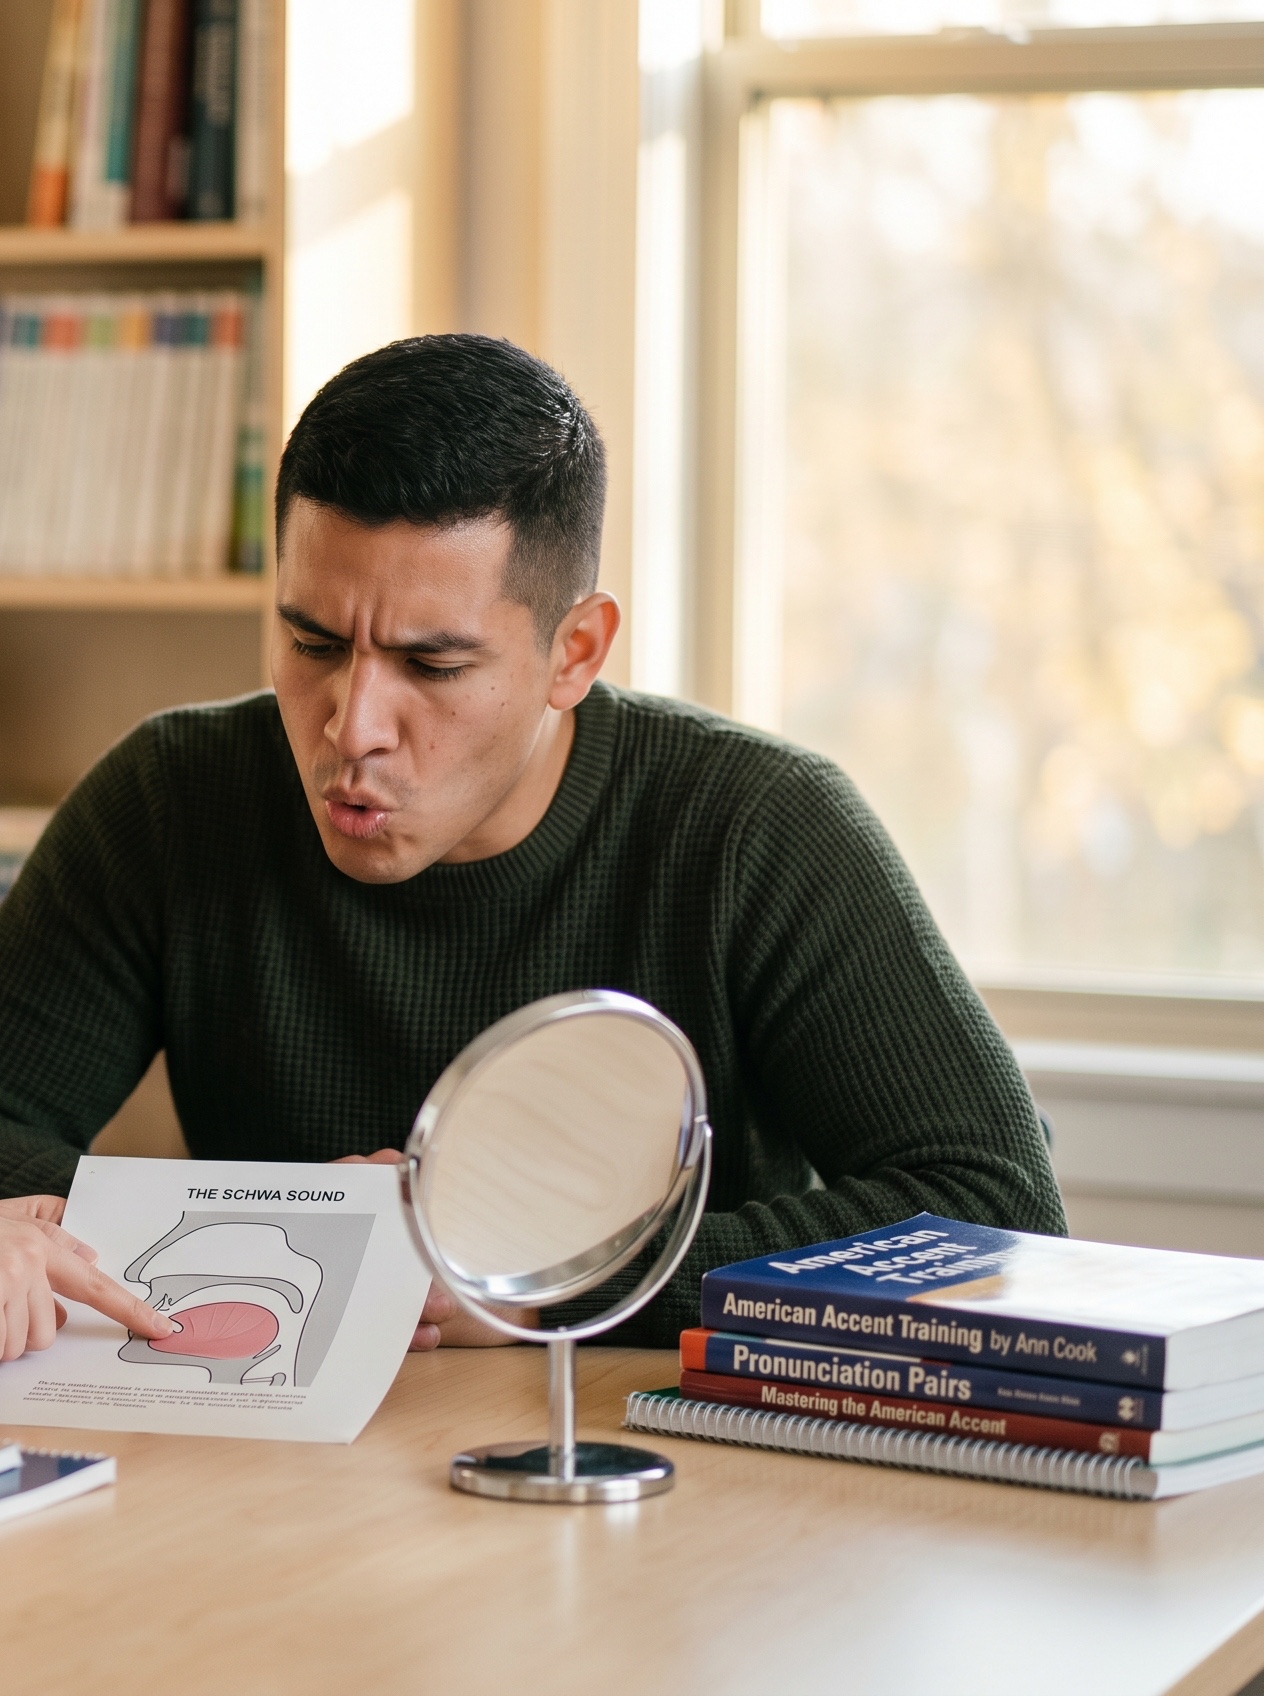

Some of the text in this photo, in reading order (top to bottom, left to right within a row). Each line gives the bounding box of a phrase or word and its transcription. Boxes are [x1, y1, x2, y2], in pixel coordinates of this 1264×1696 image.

[187, 1188, 345, 1202] THE SCHWA SOUND
[768, 1229, 949, 1274] American
[843, 1242, 977, 1276] Accent
[876, 1251, 1017, 1284] Trainin
[723, 1292, 1097, 1363] American Accent Training by Ann Cook
[733, 1344, 901, 1391] Pronunciation
[908, 1366, 972, 1401] Pairs
[761, 1385, 1007, 1436] Mastering the American Accent
